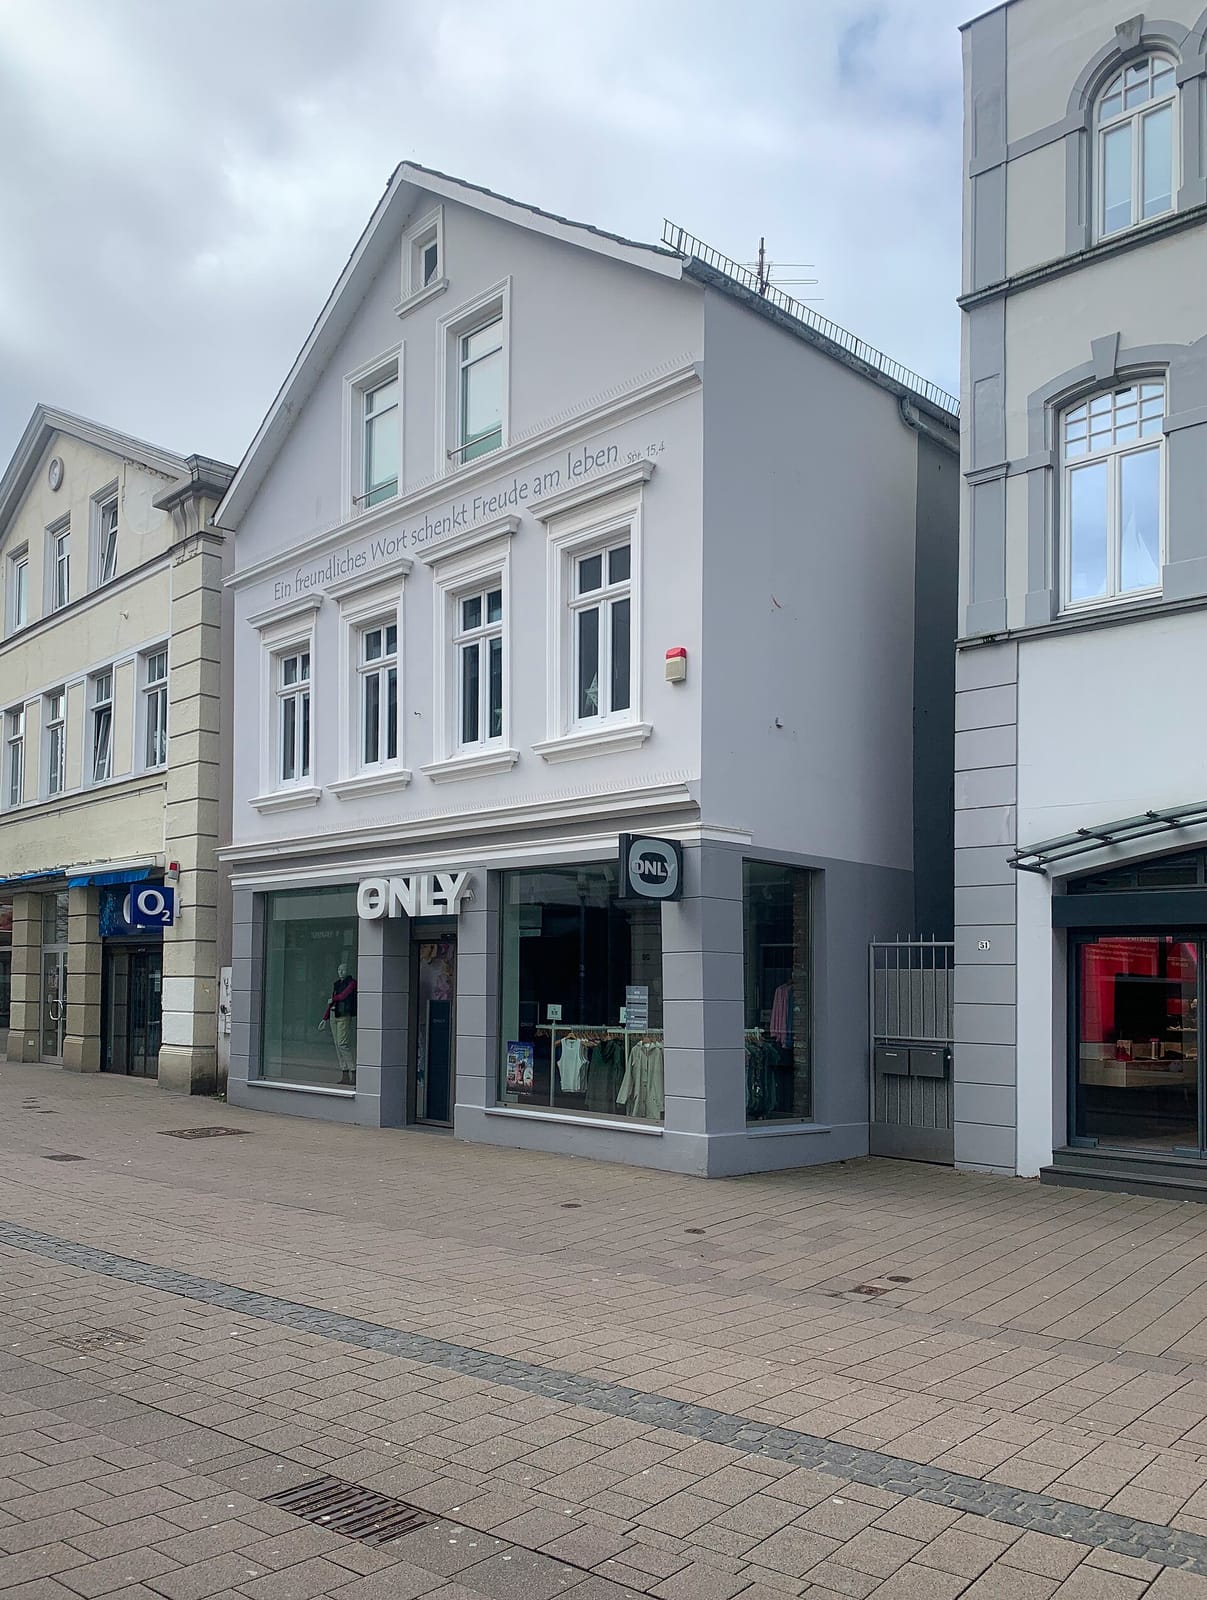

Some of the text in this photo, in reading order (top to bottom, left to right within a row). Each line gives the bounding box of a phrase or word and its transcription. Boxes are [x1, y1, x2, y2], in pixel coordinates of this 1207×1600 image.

[274, 582, 291, 600] Ein
[295, 549, 367, 593] freundliches
[371, 530, 408, 561] Wort
[411, 503, 468, 546] schenkt
[473, 479, 528, 520] Freude
[533, 470, 560, 495] am
[568, 445, 618, 480] leben
[631, 859, 676, 878] ONLY
[357, 871, 472, 919] ONLY
